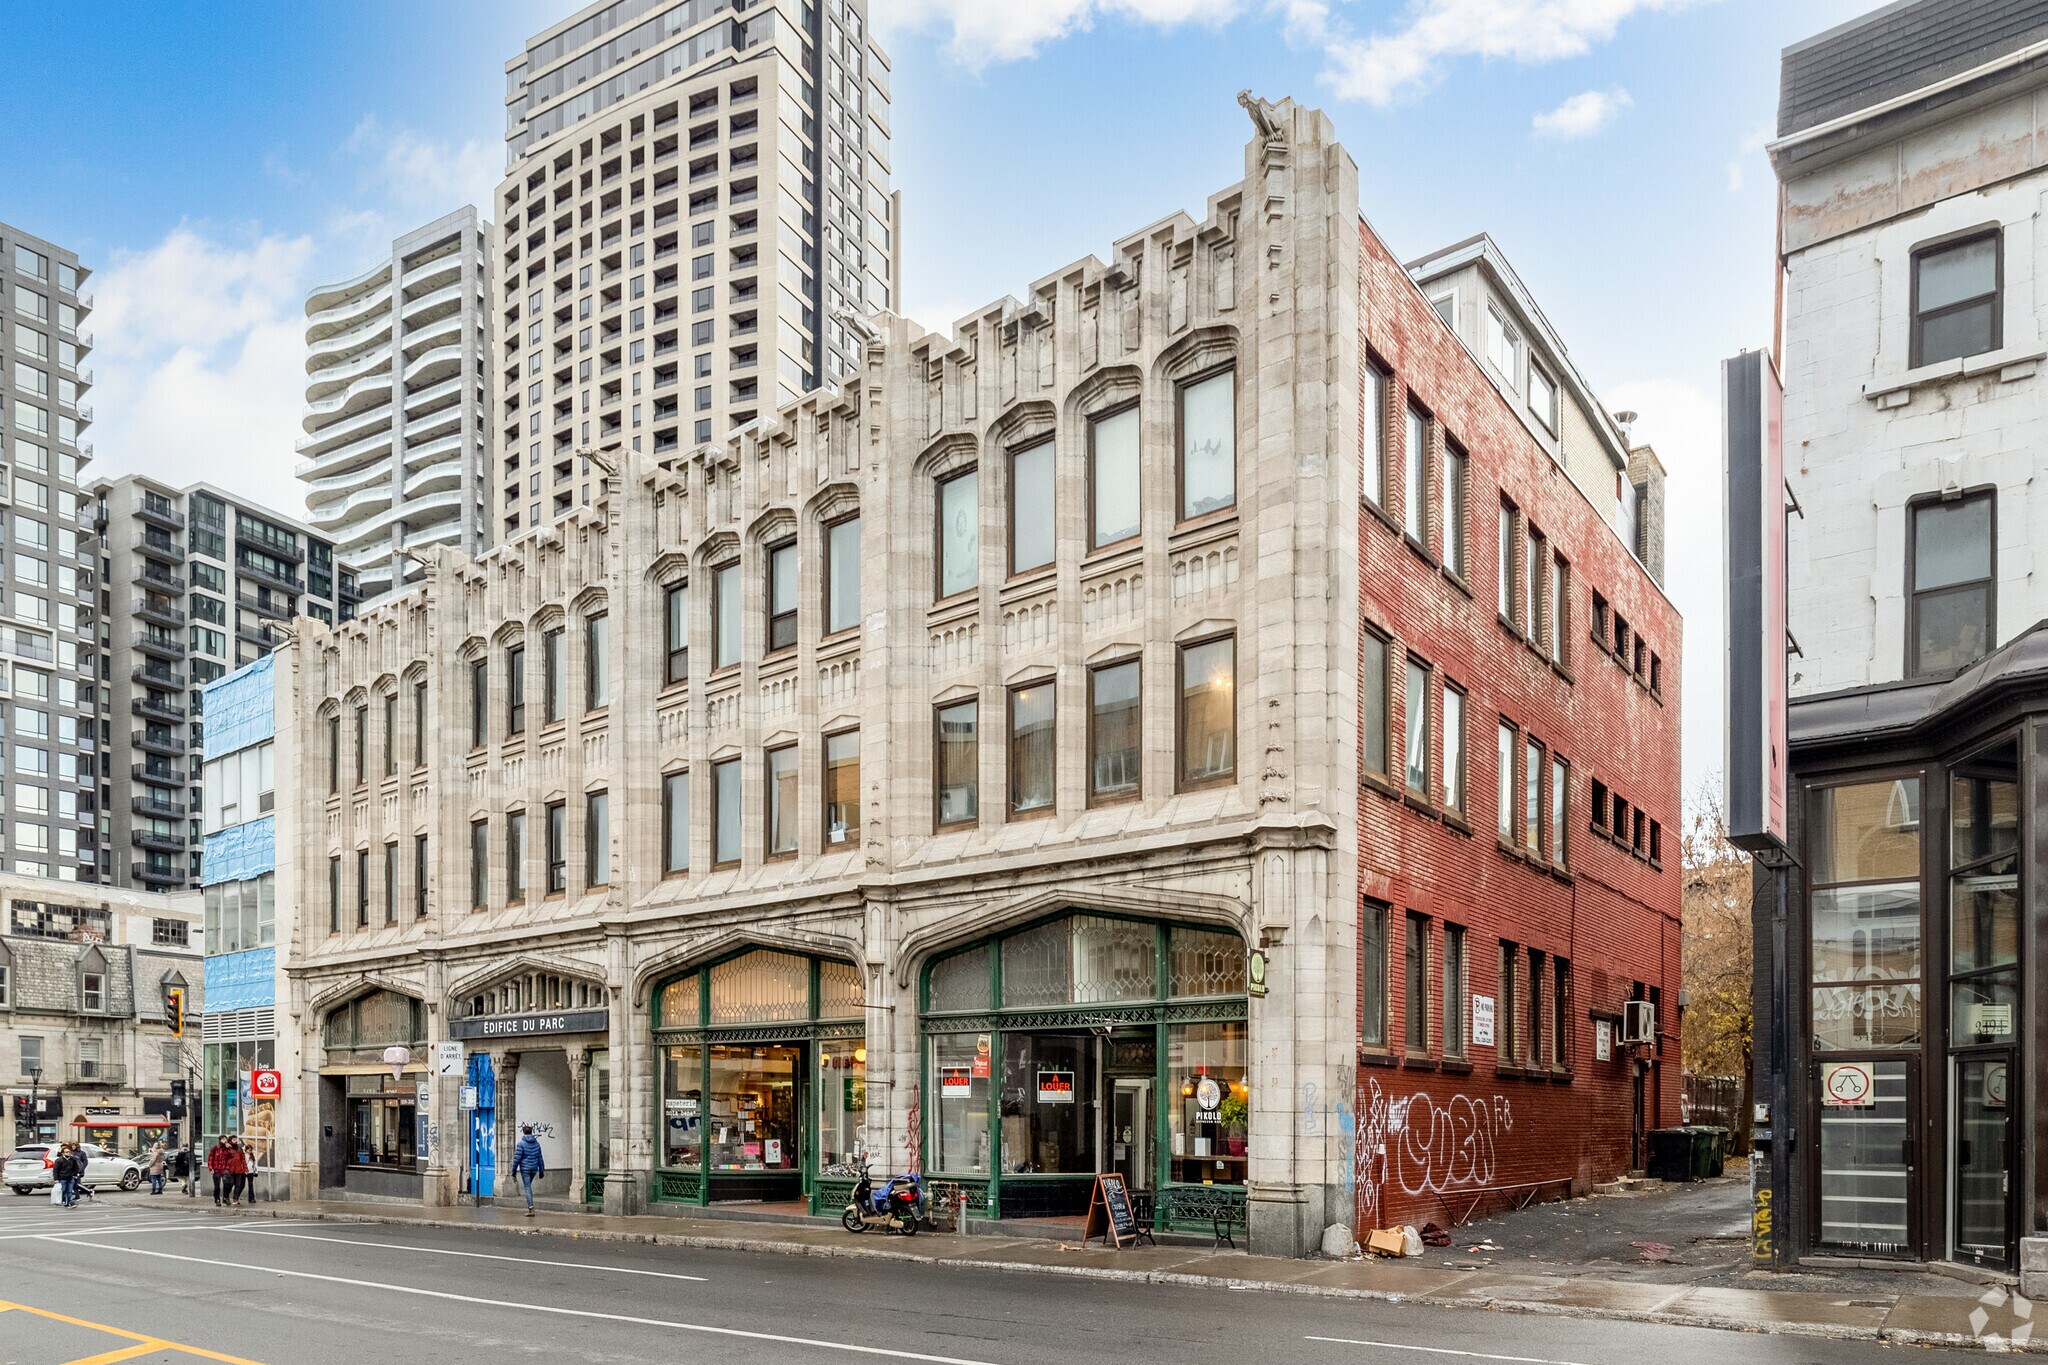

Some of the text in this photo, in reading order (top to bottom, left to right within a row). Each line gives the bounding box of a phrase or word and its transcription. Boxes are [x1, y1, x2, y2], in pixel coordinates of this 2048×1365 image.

[483, 1017, 565, 1034] ÉDIFICE DU PARC
[943, 1077, 969, 1086] LOUER
[1041, 1082, 1070, 1091] LOUER
[666, 1100, 696, 1108] papeterie
[1195, 1111, 1221, 1120] PIKOLO
